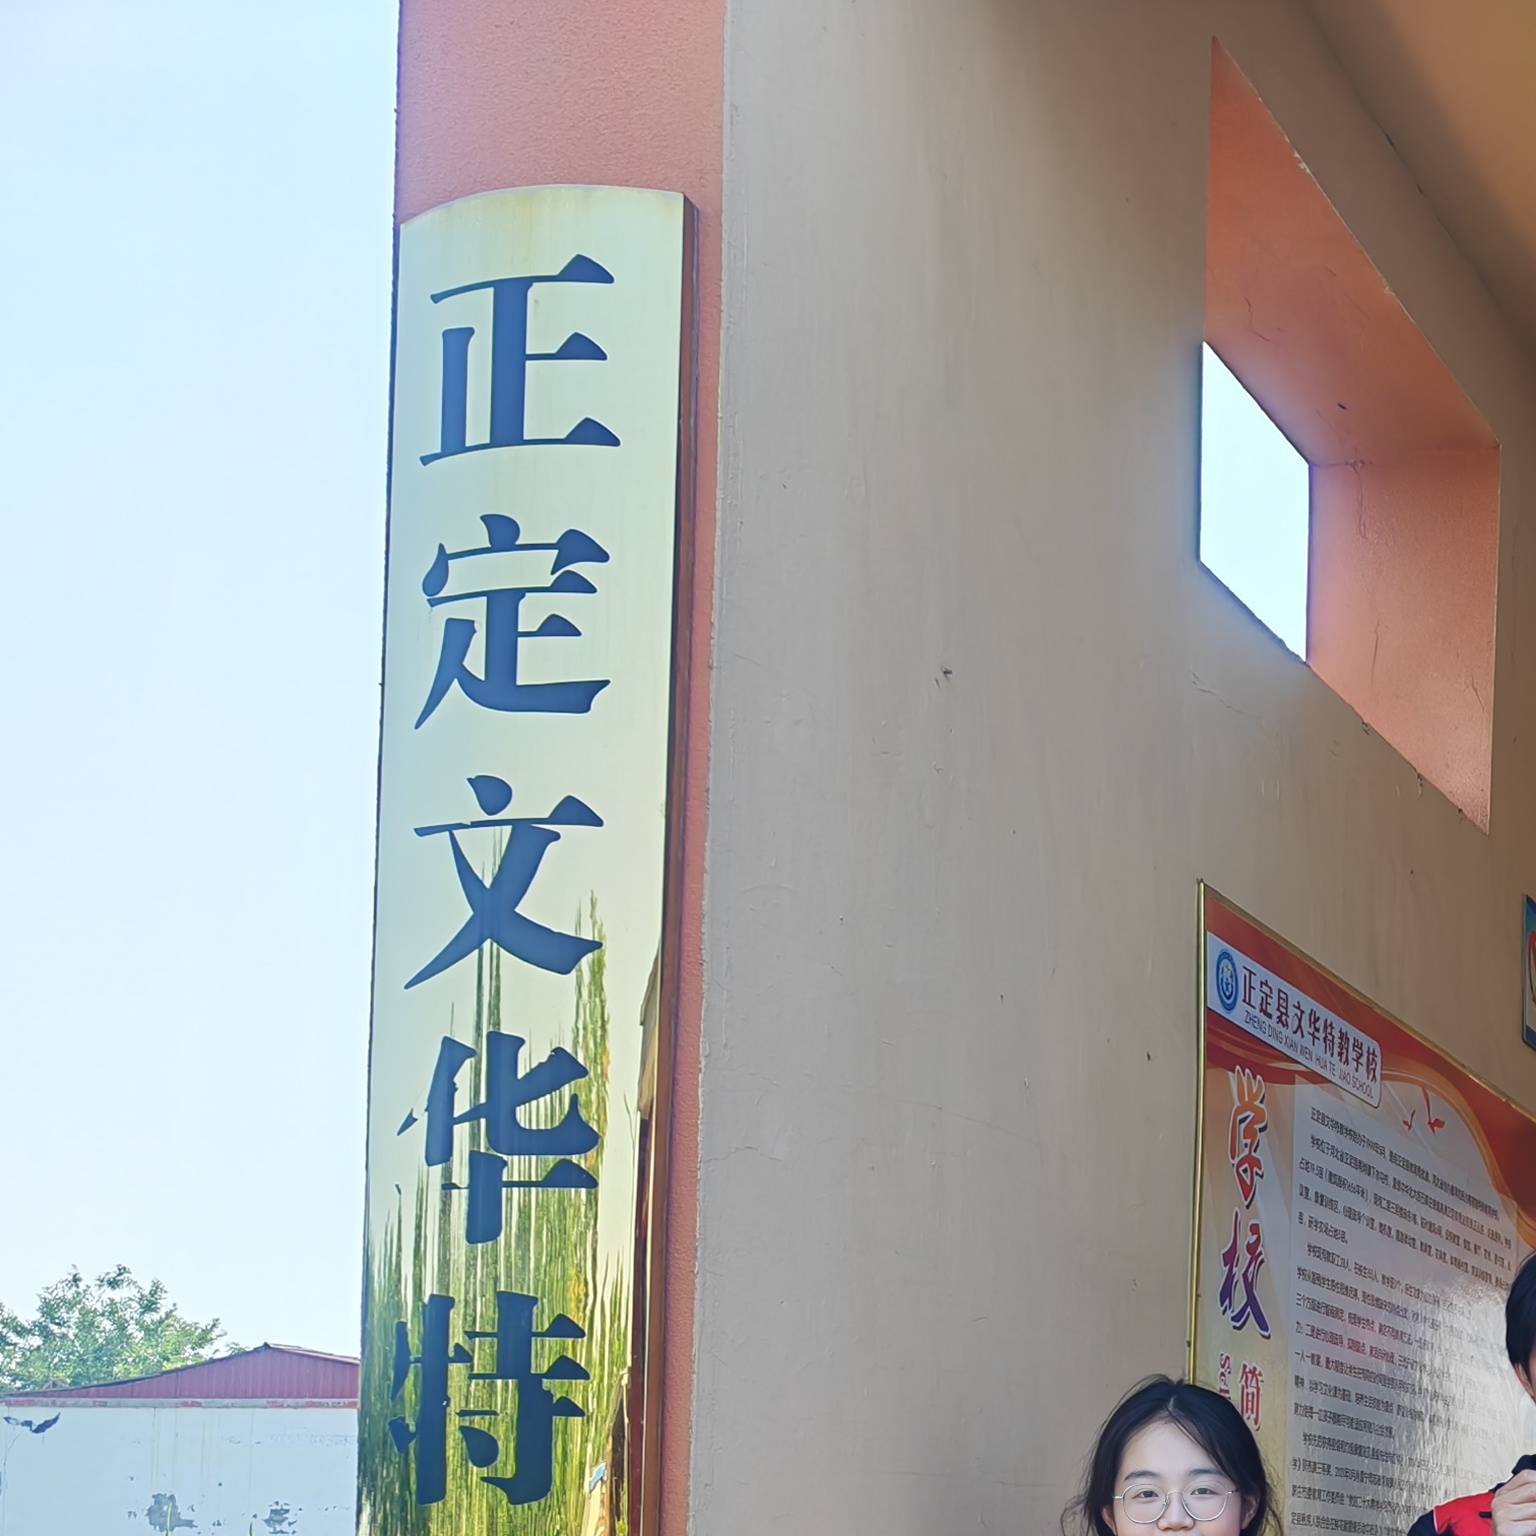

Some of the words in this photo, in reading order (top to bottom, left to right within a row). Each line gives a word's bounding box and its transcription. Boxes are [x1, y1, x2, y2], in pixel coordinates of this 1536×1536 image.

[1242, 966, 1378, 1084] 正定县文华特教学校
[1244, 1010, 1268, 1035] ZHENG
[1267, 1024, 1283, 1045] DING
[1284, 1034, 1298, 1054] XIAN
[1299, 1044, 1313, 1062] WEN
[1315, 1054, 1328, 1072] HUA
[1329, 1061, 1336, 1076] TE
[1338, 1067, 1351, 1085] JIAO
[1351, 1075, 1374, 1099] SCHOOL
